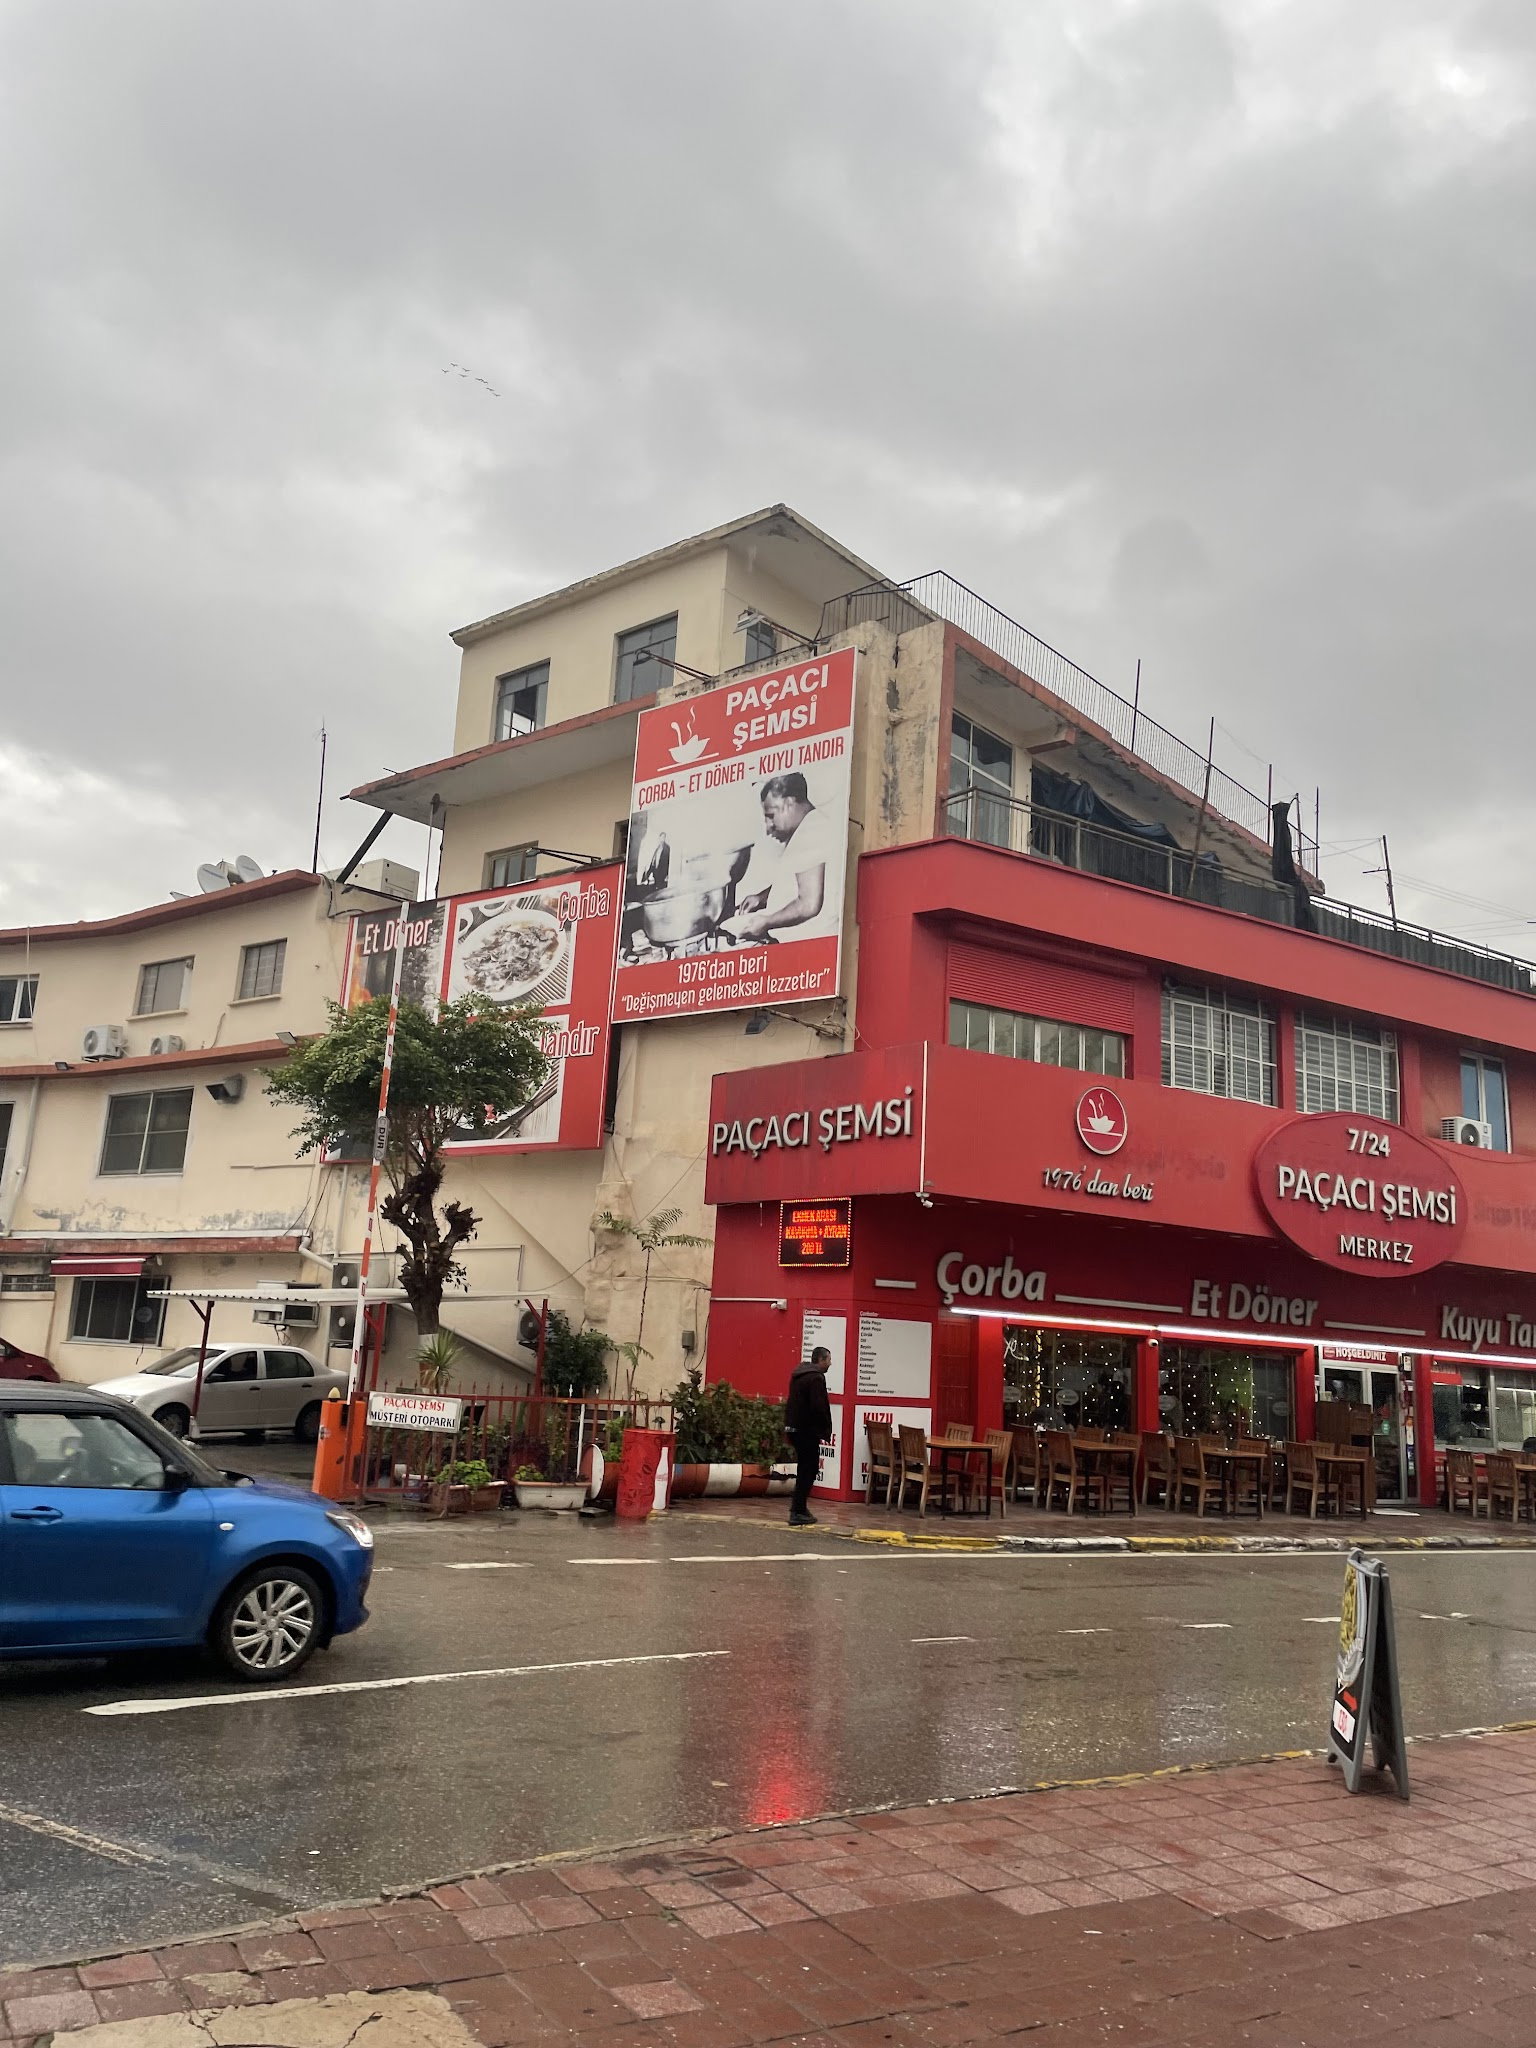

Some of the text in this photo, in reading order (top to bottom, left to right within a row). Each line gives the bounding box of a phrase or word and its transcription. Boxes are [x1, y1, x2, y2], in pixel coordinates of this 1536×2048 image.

[726, 664, 829, 716] PAÇACI
[732, 694, 817, 750] ŞEMSİ
[638, 780, 676, 810] ÇORBA
[689, 773, 703, 794] ET
[705, 762, 745, 790] DÖNER
[759, 749, 795, 776] KUYU
[798, 736, 844, 765] TANDIR
[556, 884, 610, 931] Çorba
[363, 923, 381, 955] Et
[678, 952, 768, 984] 1976'dan beri
[698, 976, 763, 1006] geleneksel
[377, 1127, 385, 1149] DUR
[712, 1085, 913, 1160] PAÇACI ŞEMSİ
[1347, 1127, 1391, 1158] 7/24
[1122, 1170, 1155, 1202] beri
[1278, 1164, 1375, 1212] PAÇACI
[1383, 1180, 1457, 1225] ŞEMSİ
[1340, 1234, 1414, 1264] MERKEZ
[936, 1251, 1046, 1305] Çorba
[1190, 1279, 1319, 1327] Et Döner
[1441, 1305, 1501, 1352] Kuyu
[370, 1409, 456, 1428] MÜŞTERİ OTOPARKI
[384, 1396, 417, 1411] PAÇACI
